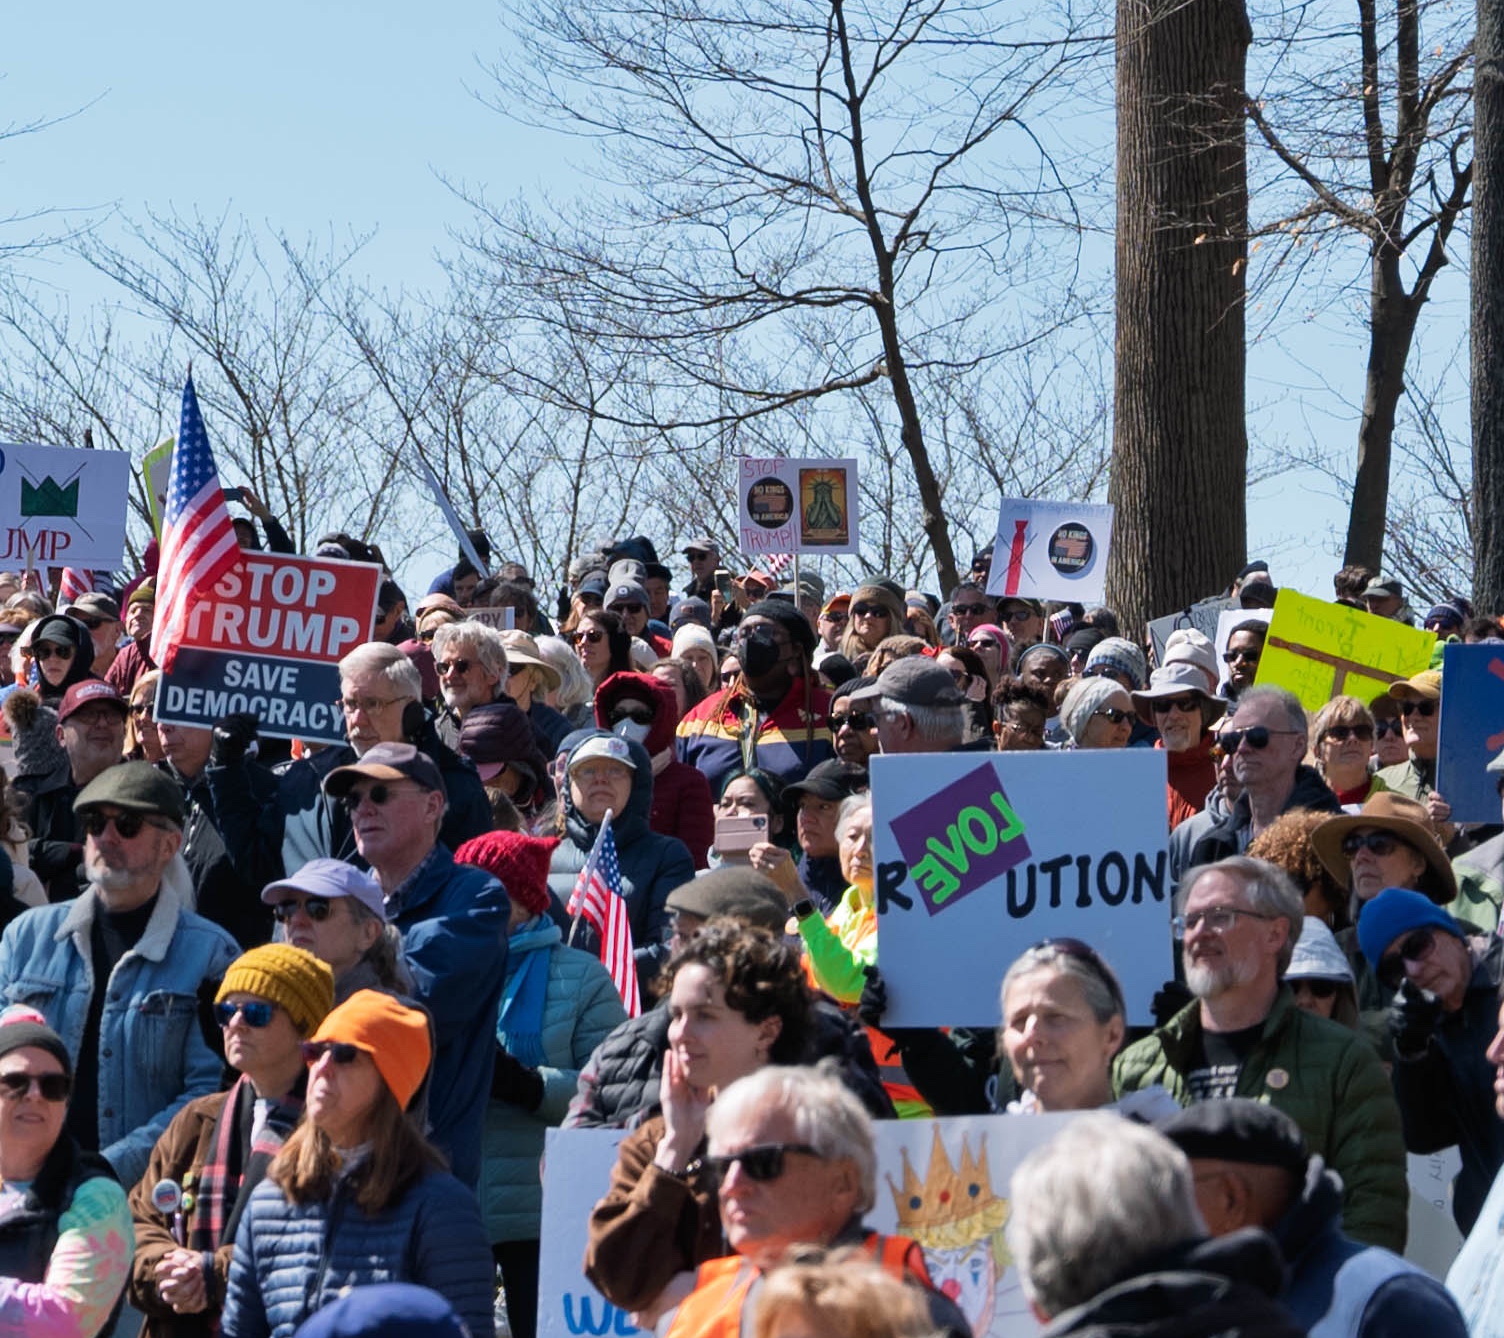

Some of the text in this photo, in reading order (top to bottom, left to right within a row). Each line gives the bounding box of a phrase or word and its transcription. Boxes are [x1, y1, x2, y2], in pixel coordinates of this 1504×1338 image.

[744, 459, 784, 478] STOP
[214, 561, 337, 608] STOP
[187, 600, 360, 656] TRUMP
[224, 660, 299, 694] SAVE
[166, 685, 345, 732] DEMOCRACY
